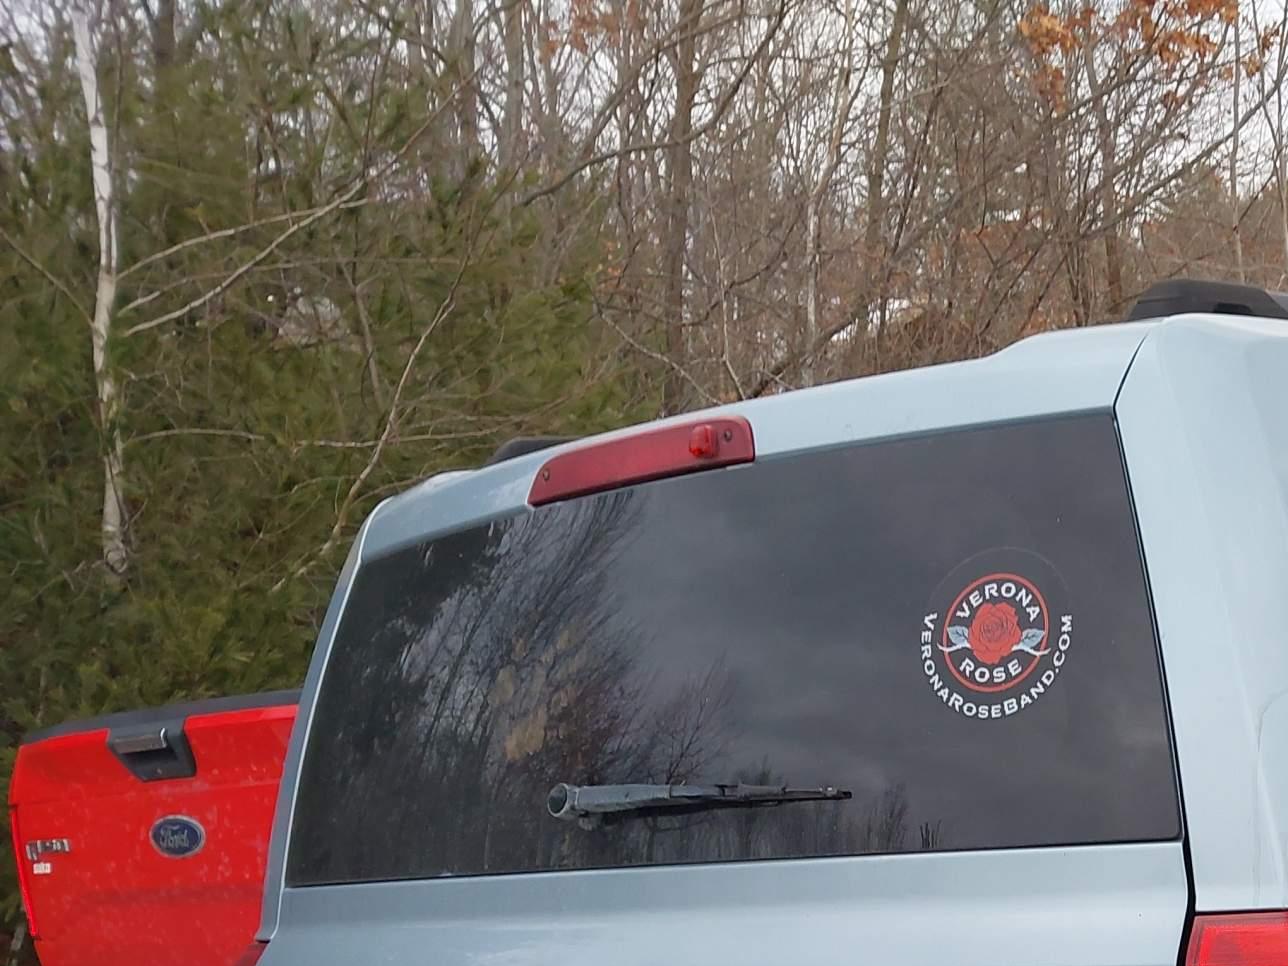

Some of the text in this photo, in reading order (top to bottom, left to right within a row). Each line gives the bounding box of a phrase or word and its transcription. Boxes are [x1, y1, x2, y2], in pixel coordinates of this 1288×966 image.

[955, 582, 1041, 623] VERONA
[959, 656, 1023, 684] ROSE
[158, 822, 190, 849] Ford
